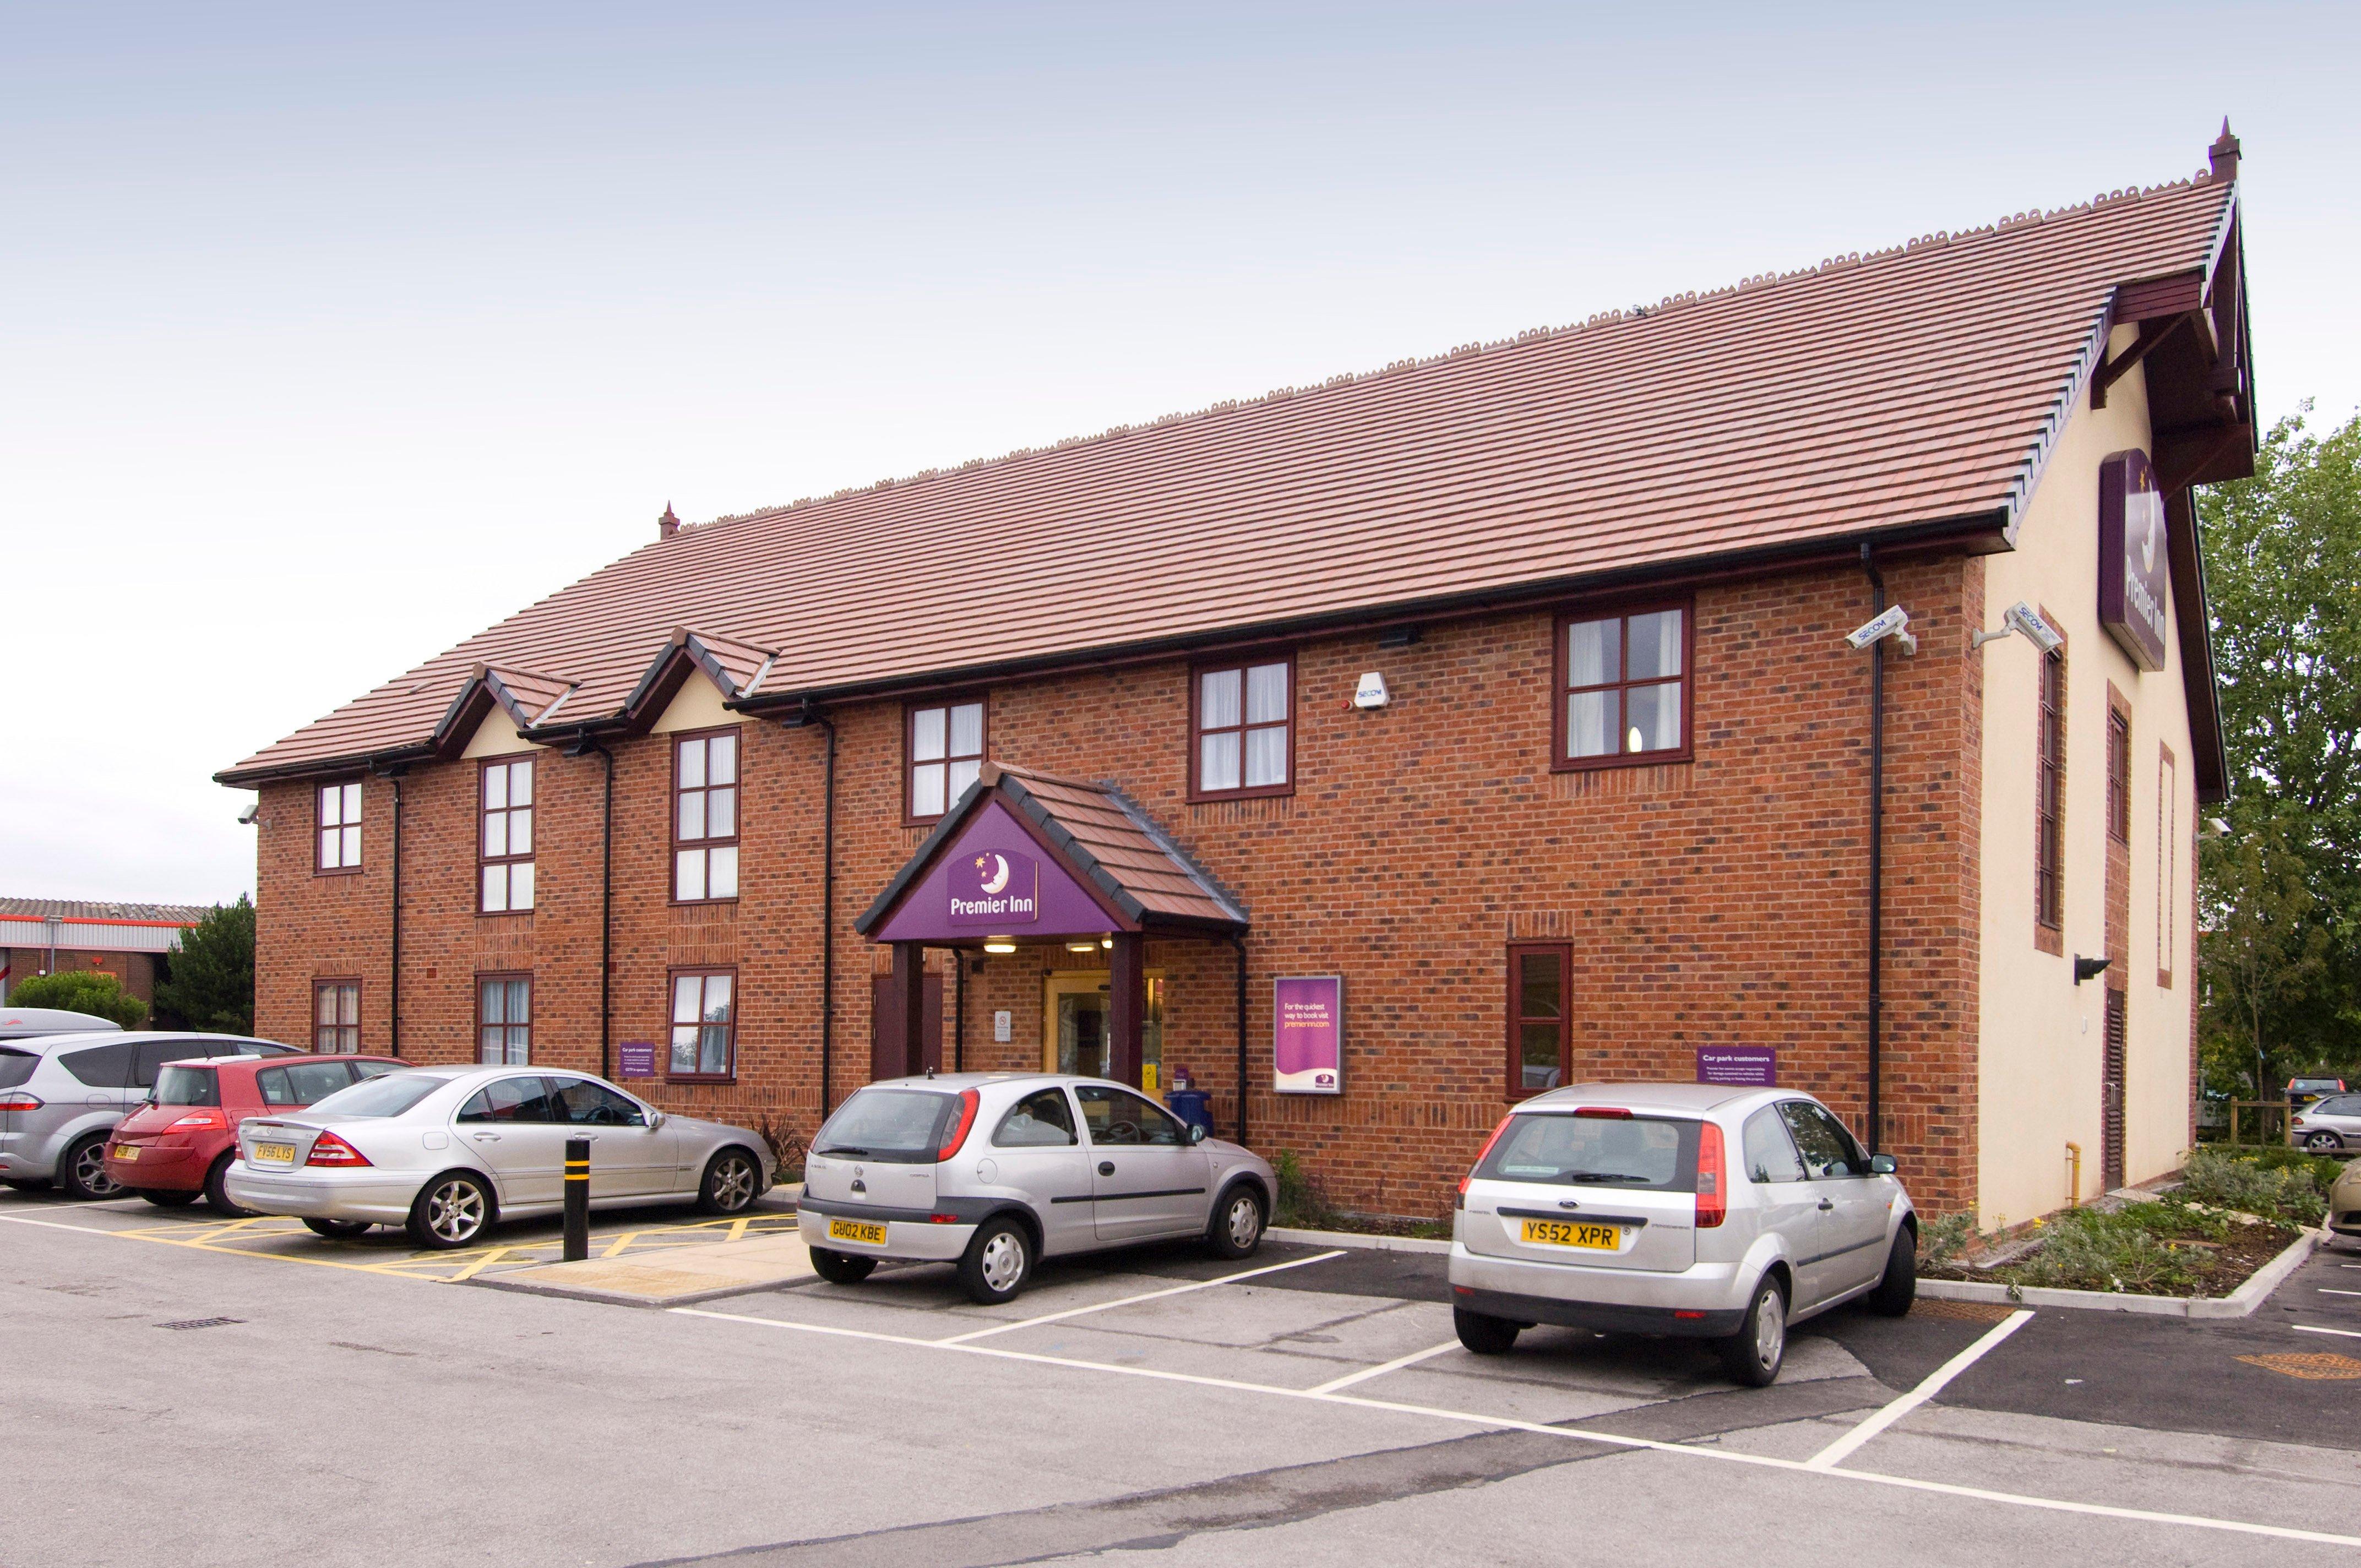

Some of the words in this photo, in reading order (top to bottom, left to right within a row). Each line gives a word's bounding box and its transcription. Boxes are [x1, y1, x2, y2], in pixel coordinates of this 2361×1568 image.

[2126, 554, 2154, 628] Premier
[2154, 596, 2164, 645] Inn
[2019, 607, 2043, 631] SECOM
[1858, 619, 1886, 640] SECOM
[1358, 689, 1381, 698] SECOM
[950, 896, 1008, 915] Premier
[1010, 895, 1032, 913] Inn
[1304, 1003, 1325, 1011] quickest
[1285, 1021, 1330, 1030] premierinn.com
[257, 1145, 276, 1157] FV56
[276, 1147, 292, 1159] LYS
[833, 1222, 858, 1238] GU02
[860, 1226, 882, 1241] KBE
[1527, 1222, 1572, 1243] YS52
[1577, 1226, 1613, 1246] XPR
